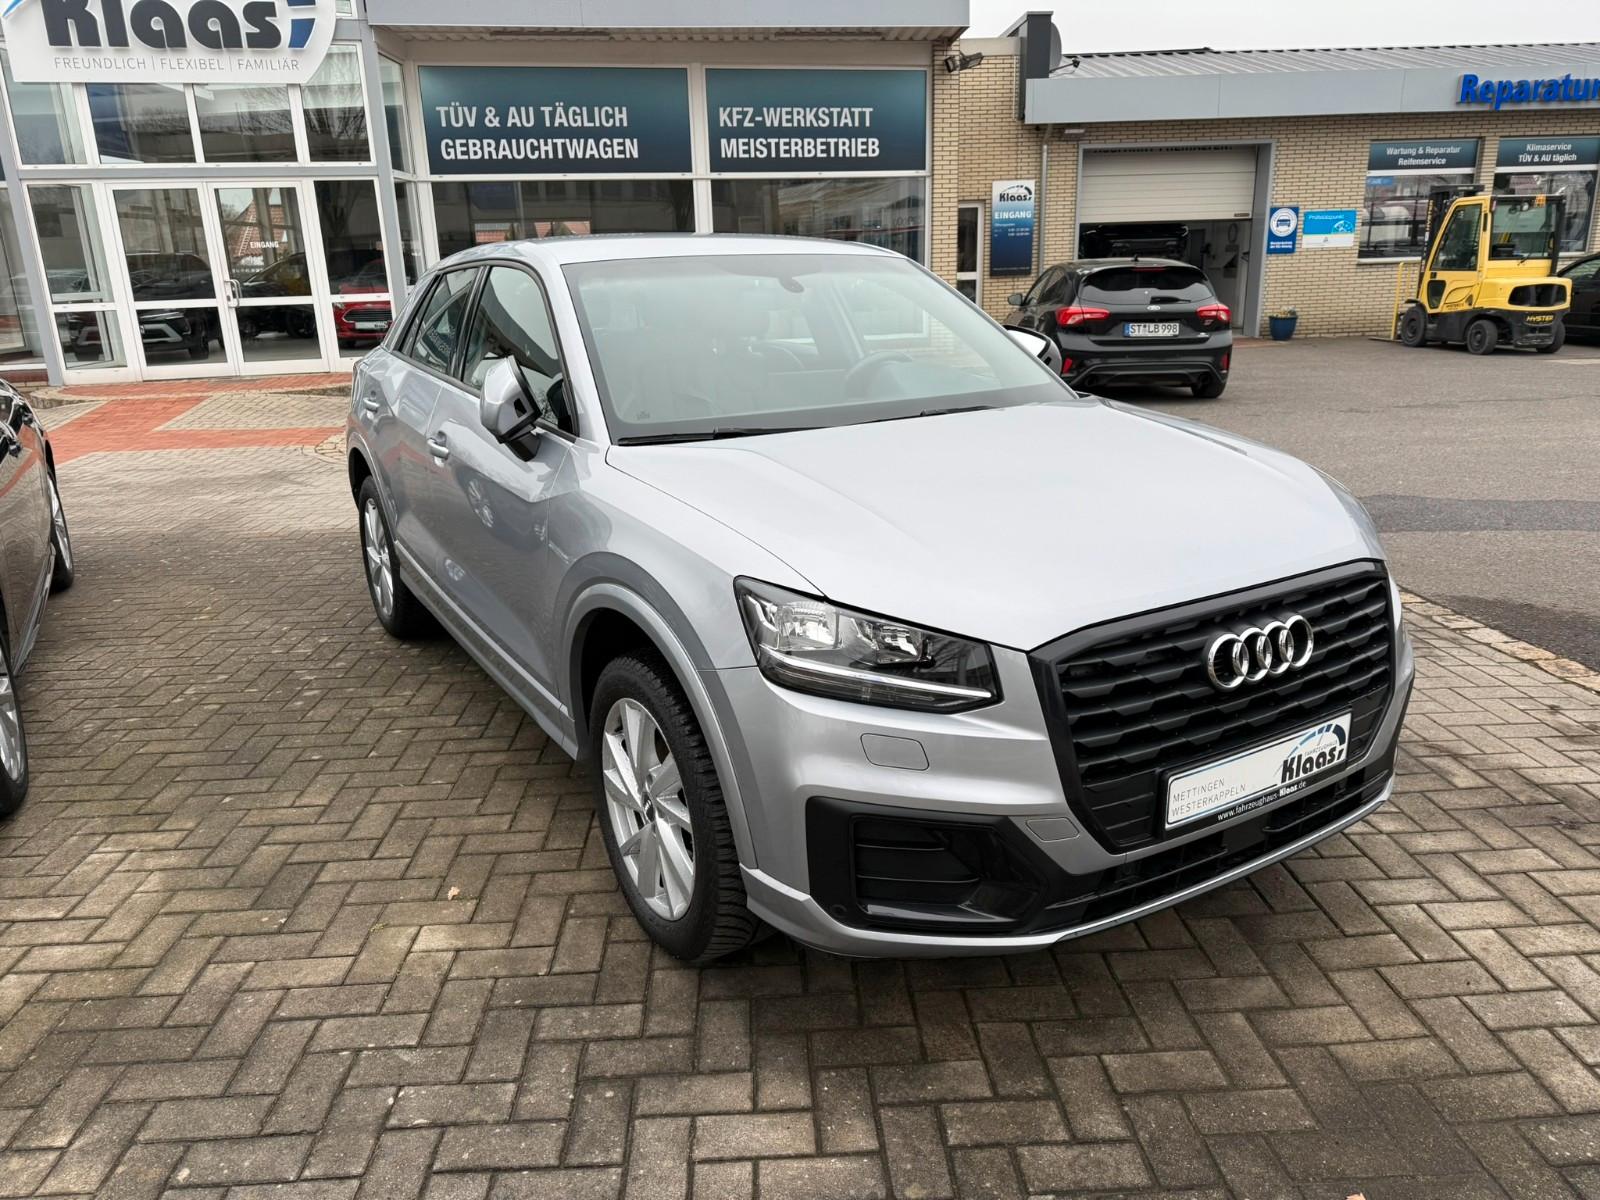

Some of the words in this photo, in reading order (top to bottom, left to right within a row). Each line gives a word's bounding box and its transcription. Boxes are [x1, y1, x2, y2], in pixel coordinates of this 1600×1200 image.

[54, 56, 147, 71] FREUNDLICH
[160, 57, 225, 72] FLEXIBEL
[237, 57, 300, 71] FAMILIÄR
[436, 103, 477, 128] TÜV
[484, 108, 501, 127] &
[507, 107, 535, 127] AU
[541, 103, 628, 127] TÄGLICH
[719, 106, 874, 128] KFZ-WERKSTATT
[440, 137, 639, 160] GEBRAUCHTWAGEN
[720, 136, 881, 158] MEISTERBETRIEB
[1386, 147, 1417, 156] Wartung
[1425, 146, 1461, 155] Reparatur
[1526, 143, 1572, 151] Klimaservice
[1398, 157, 1447, 166] Reifenservice
[1519, 153, 1533, 162] TÜV
[1533, 154, 1540, 162] &
[1541, 154, 1552, 162] AU
[1552, 153, 1577, 163] täglich
[999, 193, 1028, 202] Klaas
[994, 211, 1032, 219] EINGANG
[1161, 324, 1178, 333] 998
[1281, 746, 1337, 784] Klaas
[1173, 778, 1225, 802] METTINGEN
[1171, 784, 1246, 816] WESTERKAPPELN
